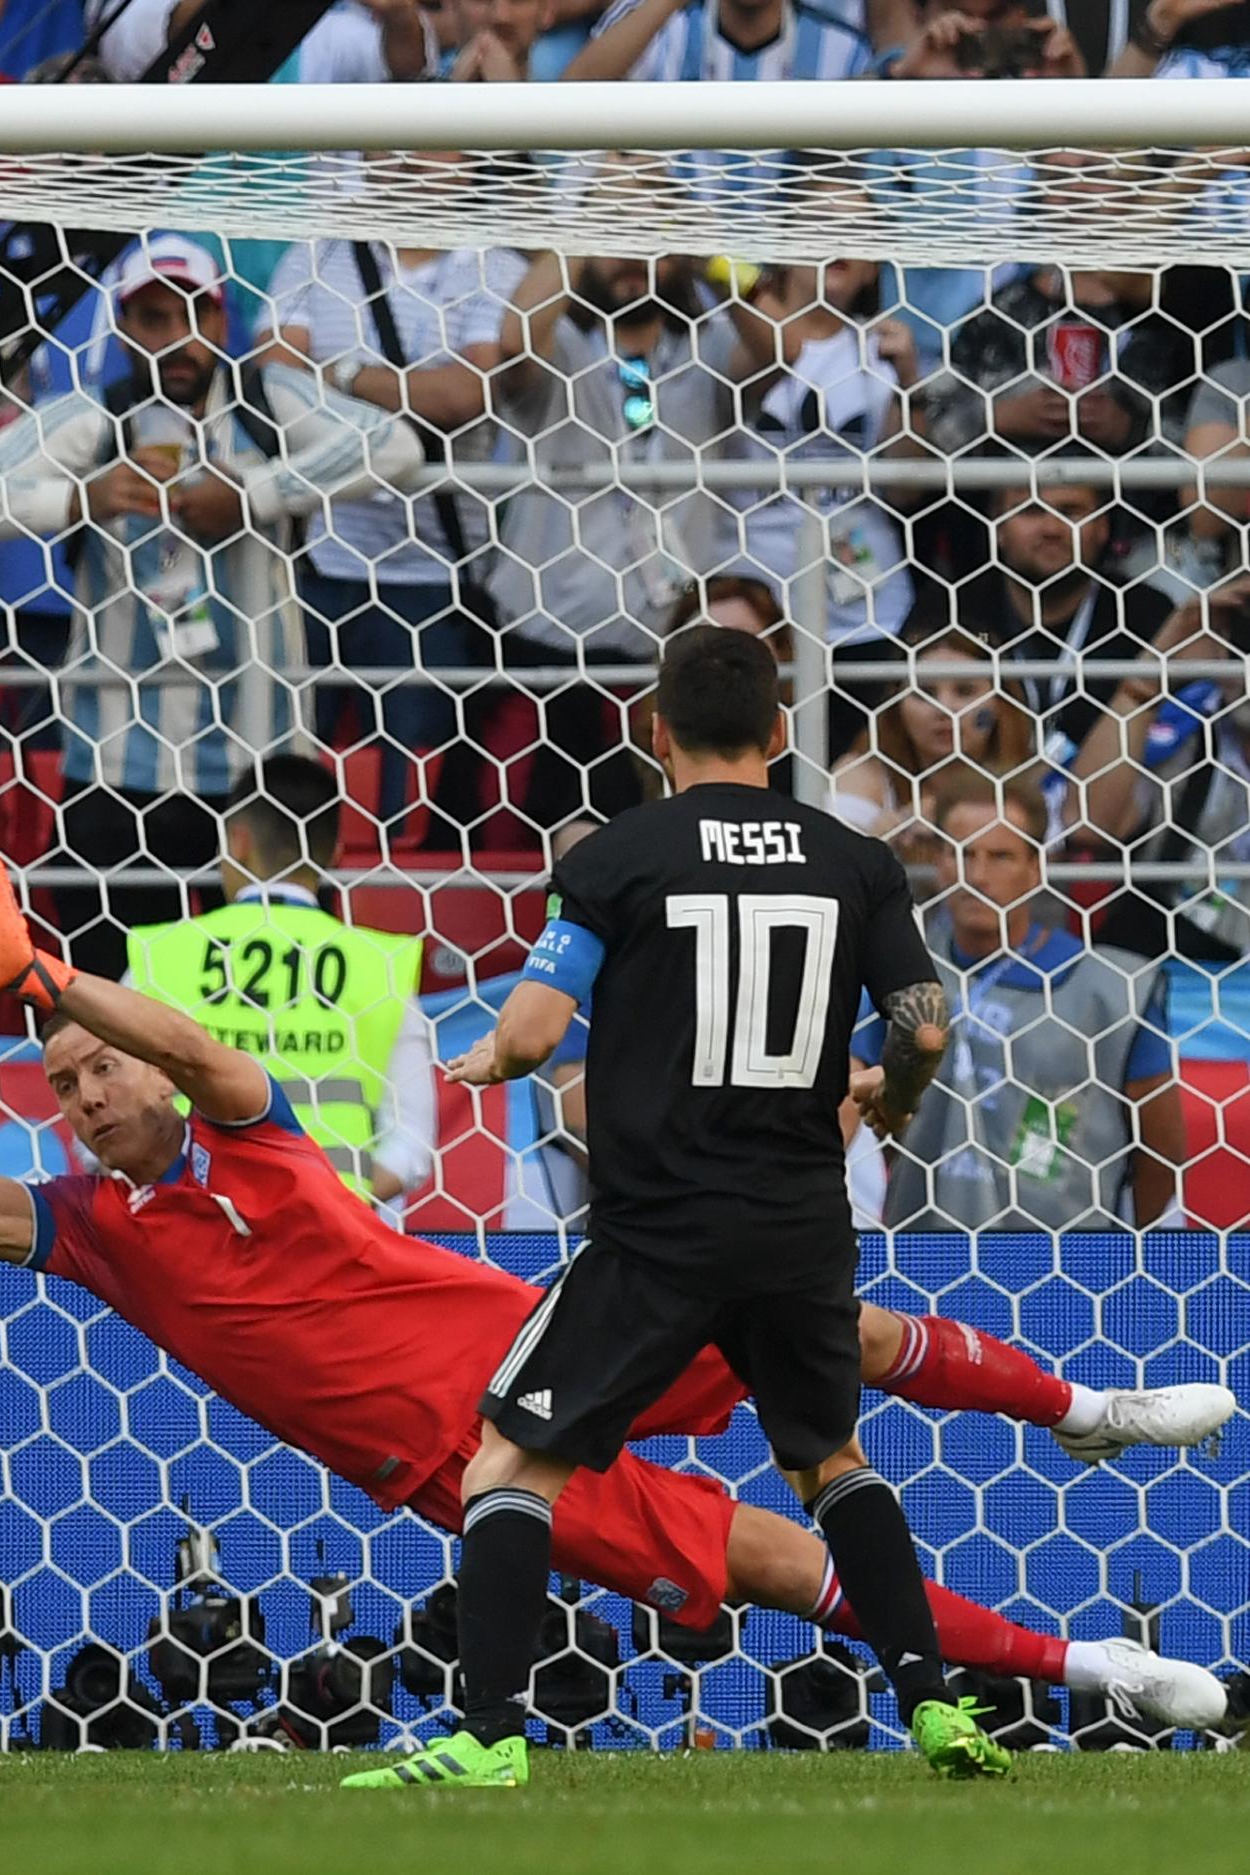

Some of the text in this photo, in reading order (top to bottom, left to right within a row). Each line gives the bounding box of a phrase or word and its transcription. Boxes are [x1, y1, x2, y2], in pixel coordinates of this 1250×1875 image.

[699, 819, 807, 865] MESSI
[200, 936, 347, 1011] 5210
[666, 893, 840, 1089] 10
[206, 1026, 345, 1053] TEWARD
